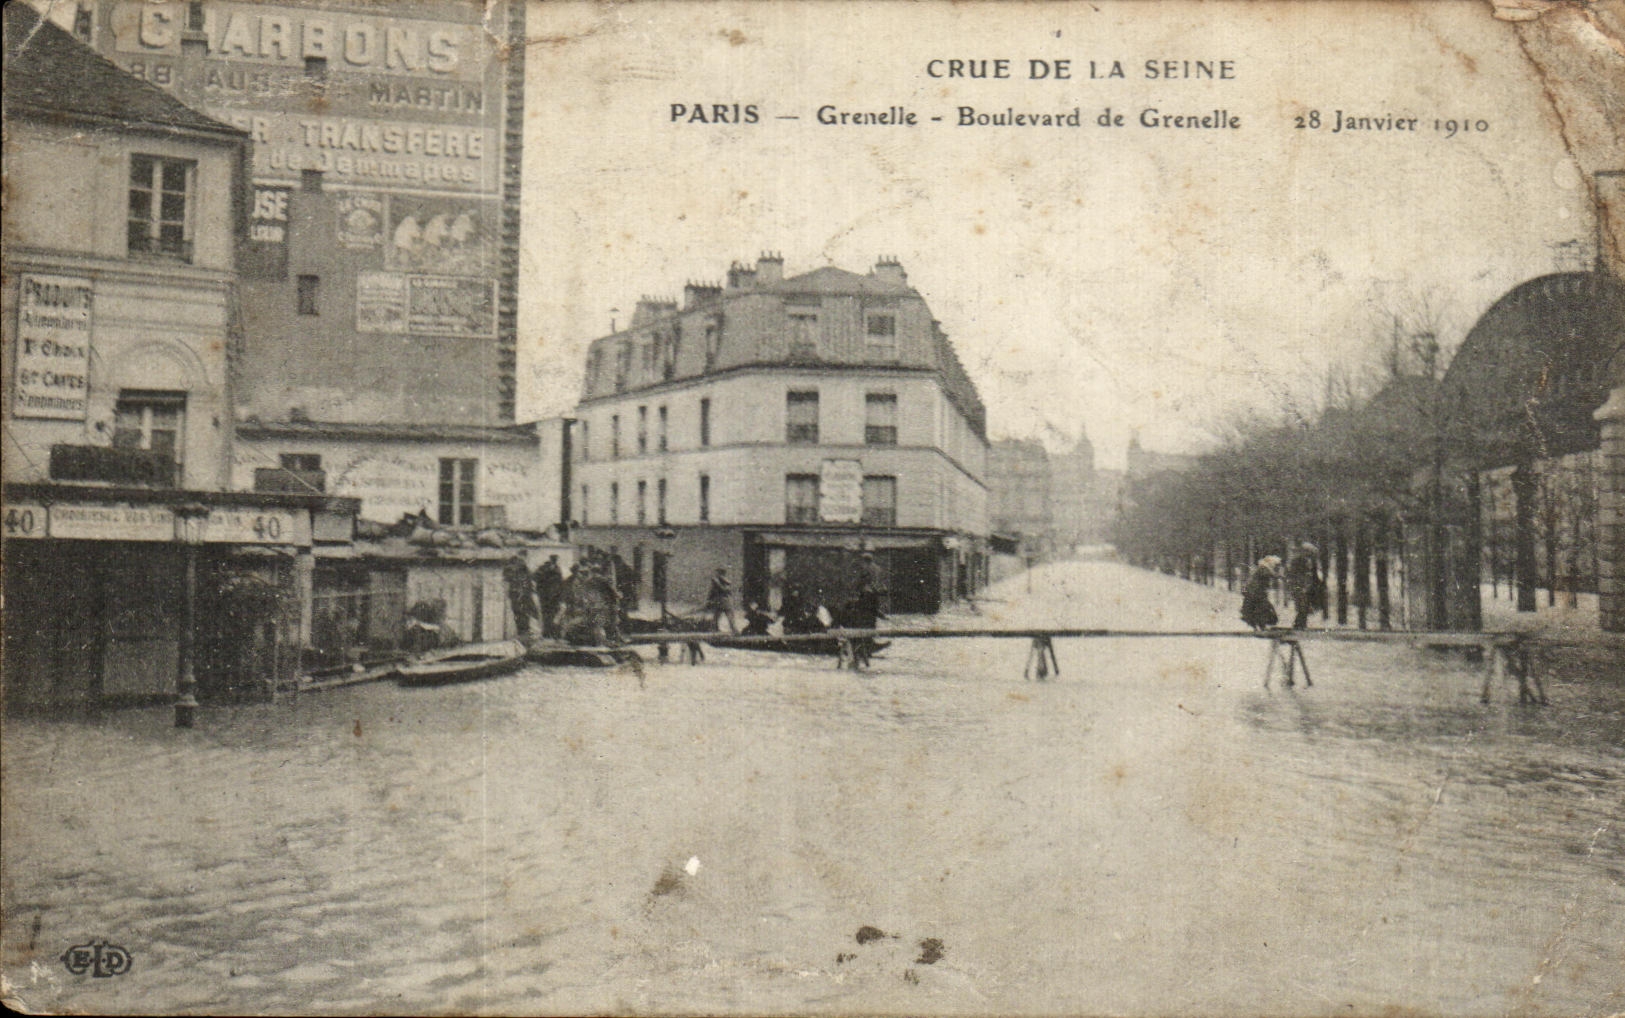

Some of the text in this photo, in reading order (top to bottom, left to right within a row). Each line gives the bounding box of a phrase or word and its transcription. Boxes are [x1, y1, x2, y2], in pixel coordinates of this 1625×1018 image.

[369, 81, 484, 114] MARTIN
[4, 508, 35, 535] 40
[253, 515, 281, 539] 40
